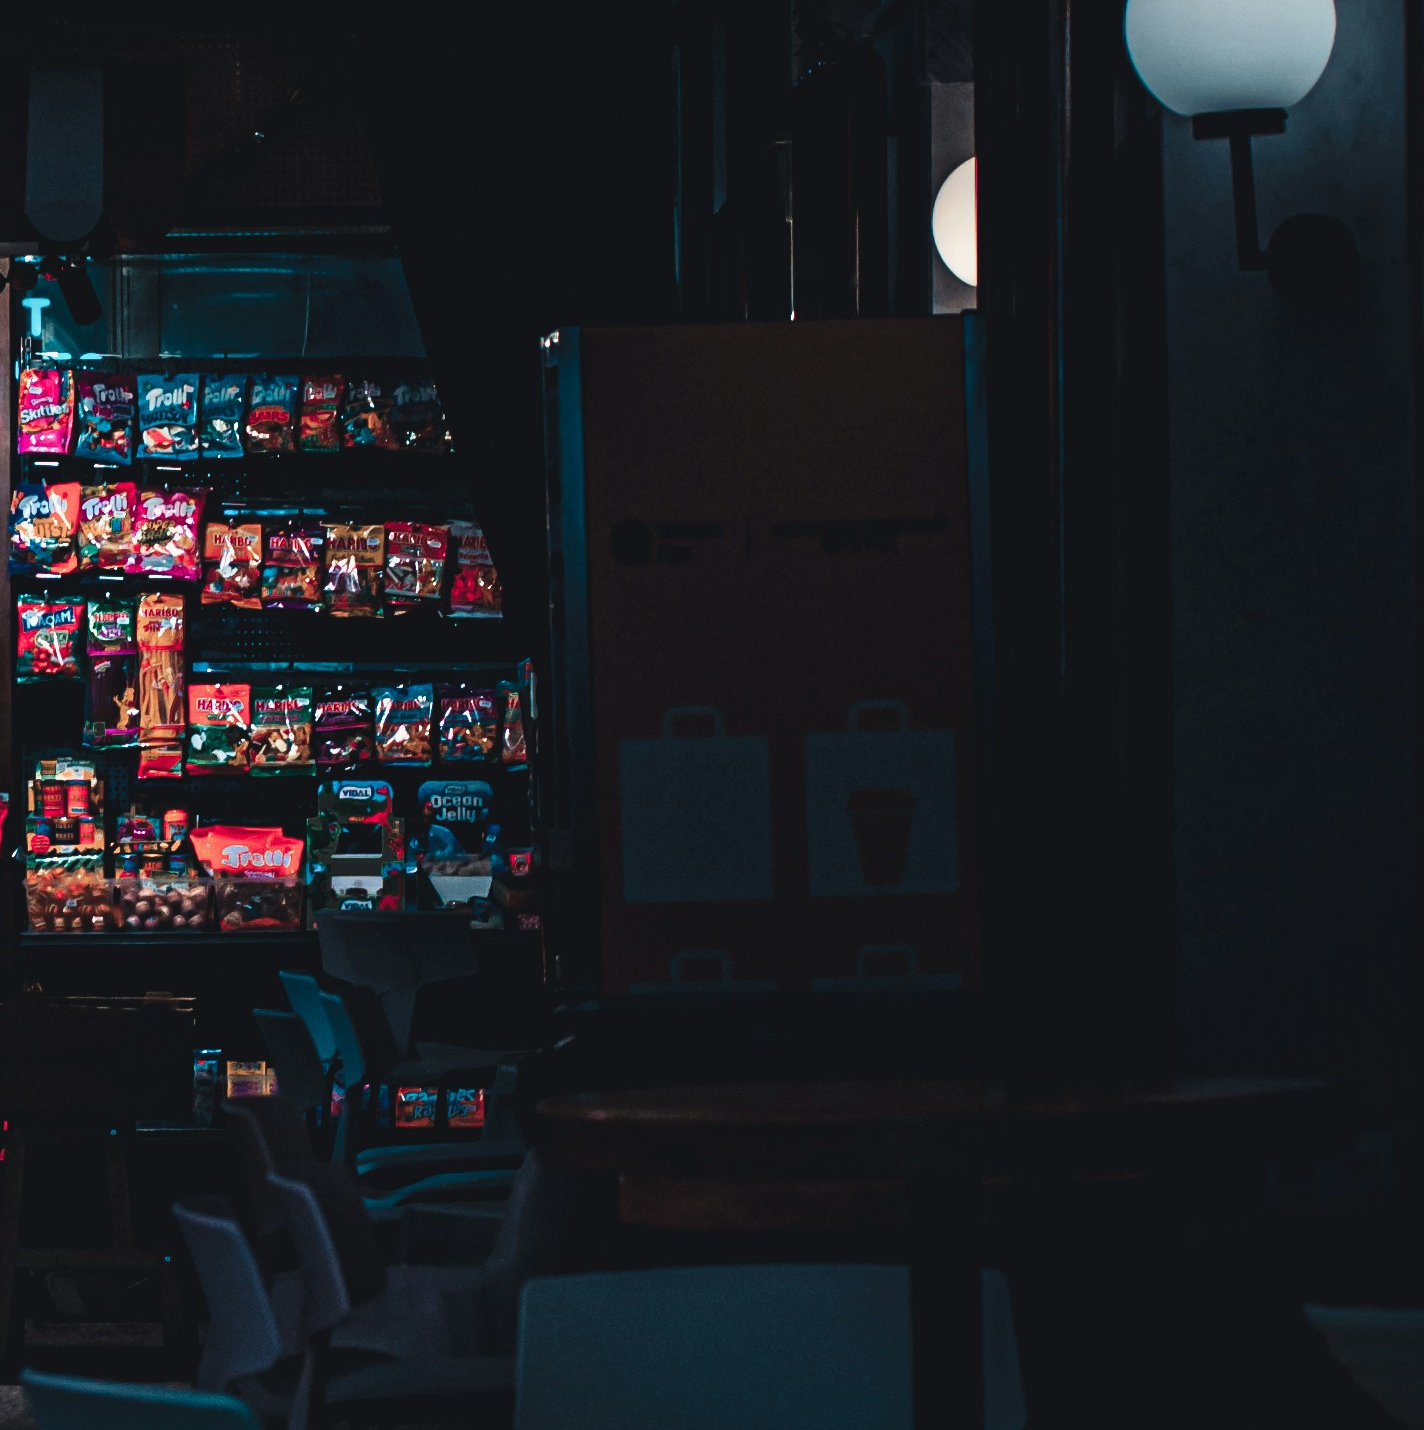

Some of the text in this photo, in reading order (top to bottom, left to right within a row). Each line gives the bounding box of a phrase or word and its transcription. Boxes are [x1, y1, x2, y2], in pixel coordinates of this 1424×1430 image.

[145, 384, 194, 412] Trolli
[18, 494, 68, 519] Trolli
[82, 493, 128, 521] Trolli
[392, 531, 438, 547] HARIB
[140, 607, 179, 618] HARIBO
[342, 788, 371, 798] VIDAL
[430, 794, 484, 809] Ocean
[435, 807, 477, 823] Jelly
[221, 844, 295, 870] Trolli
